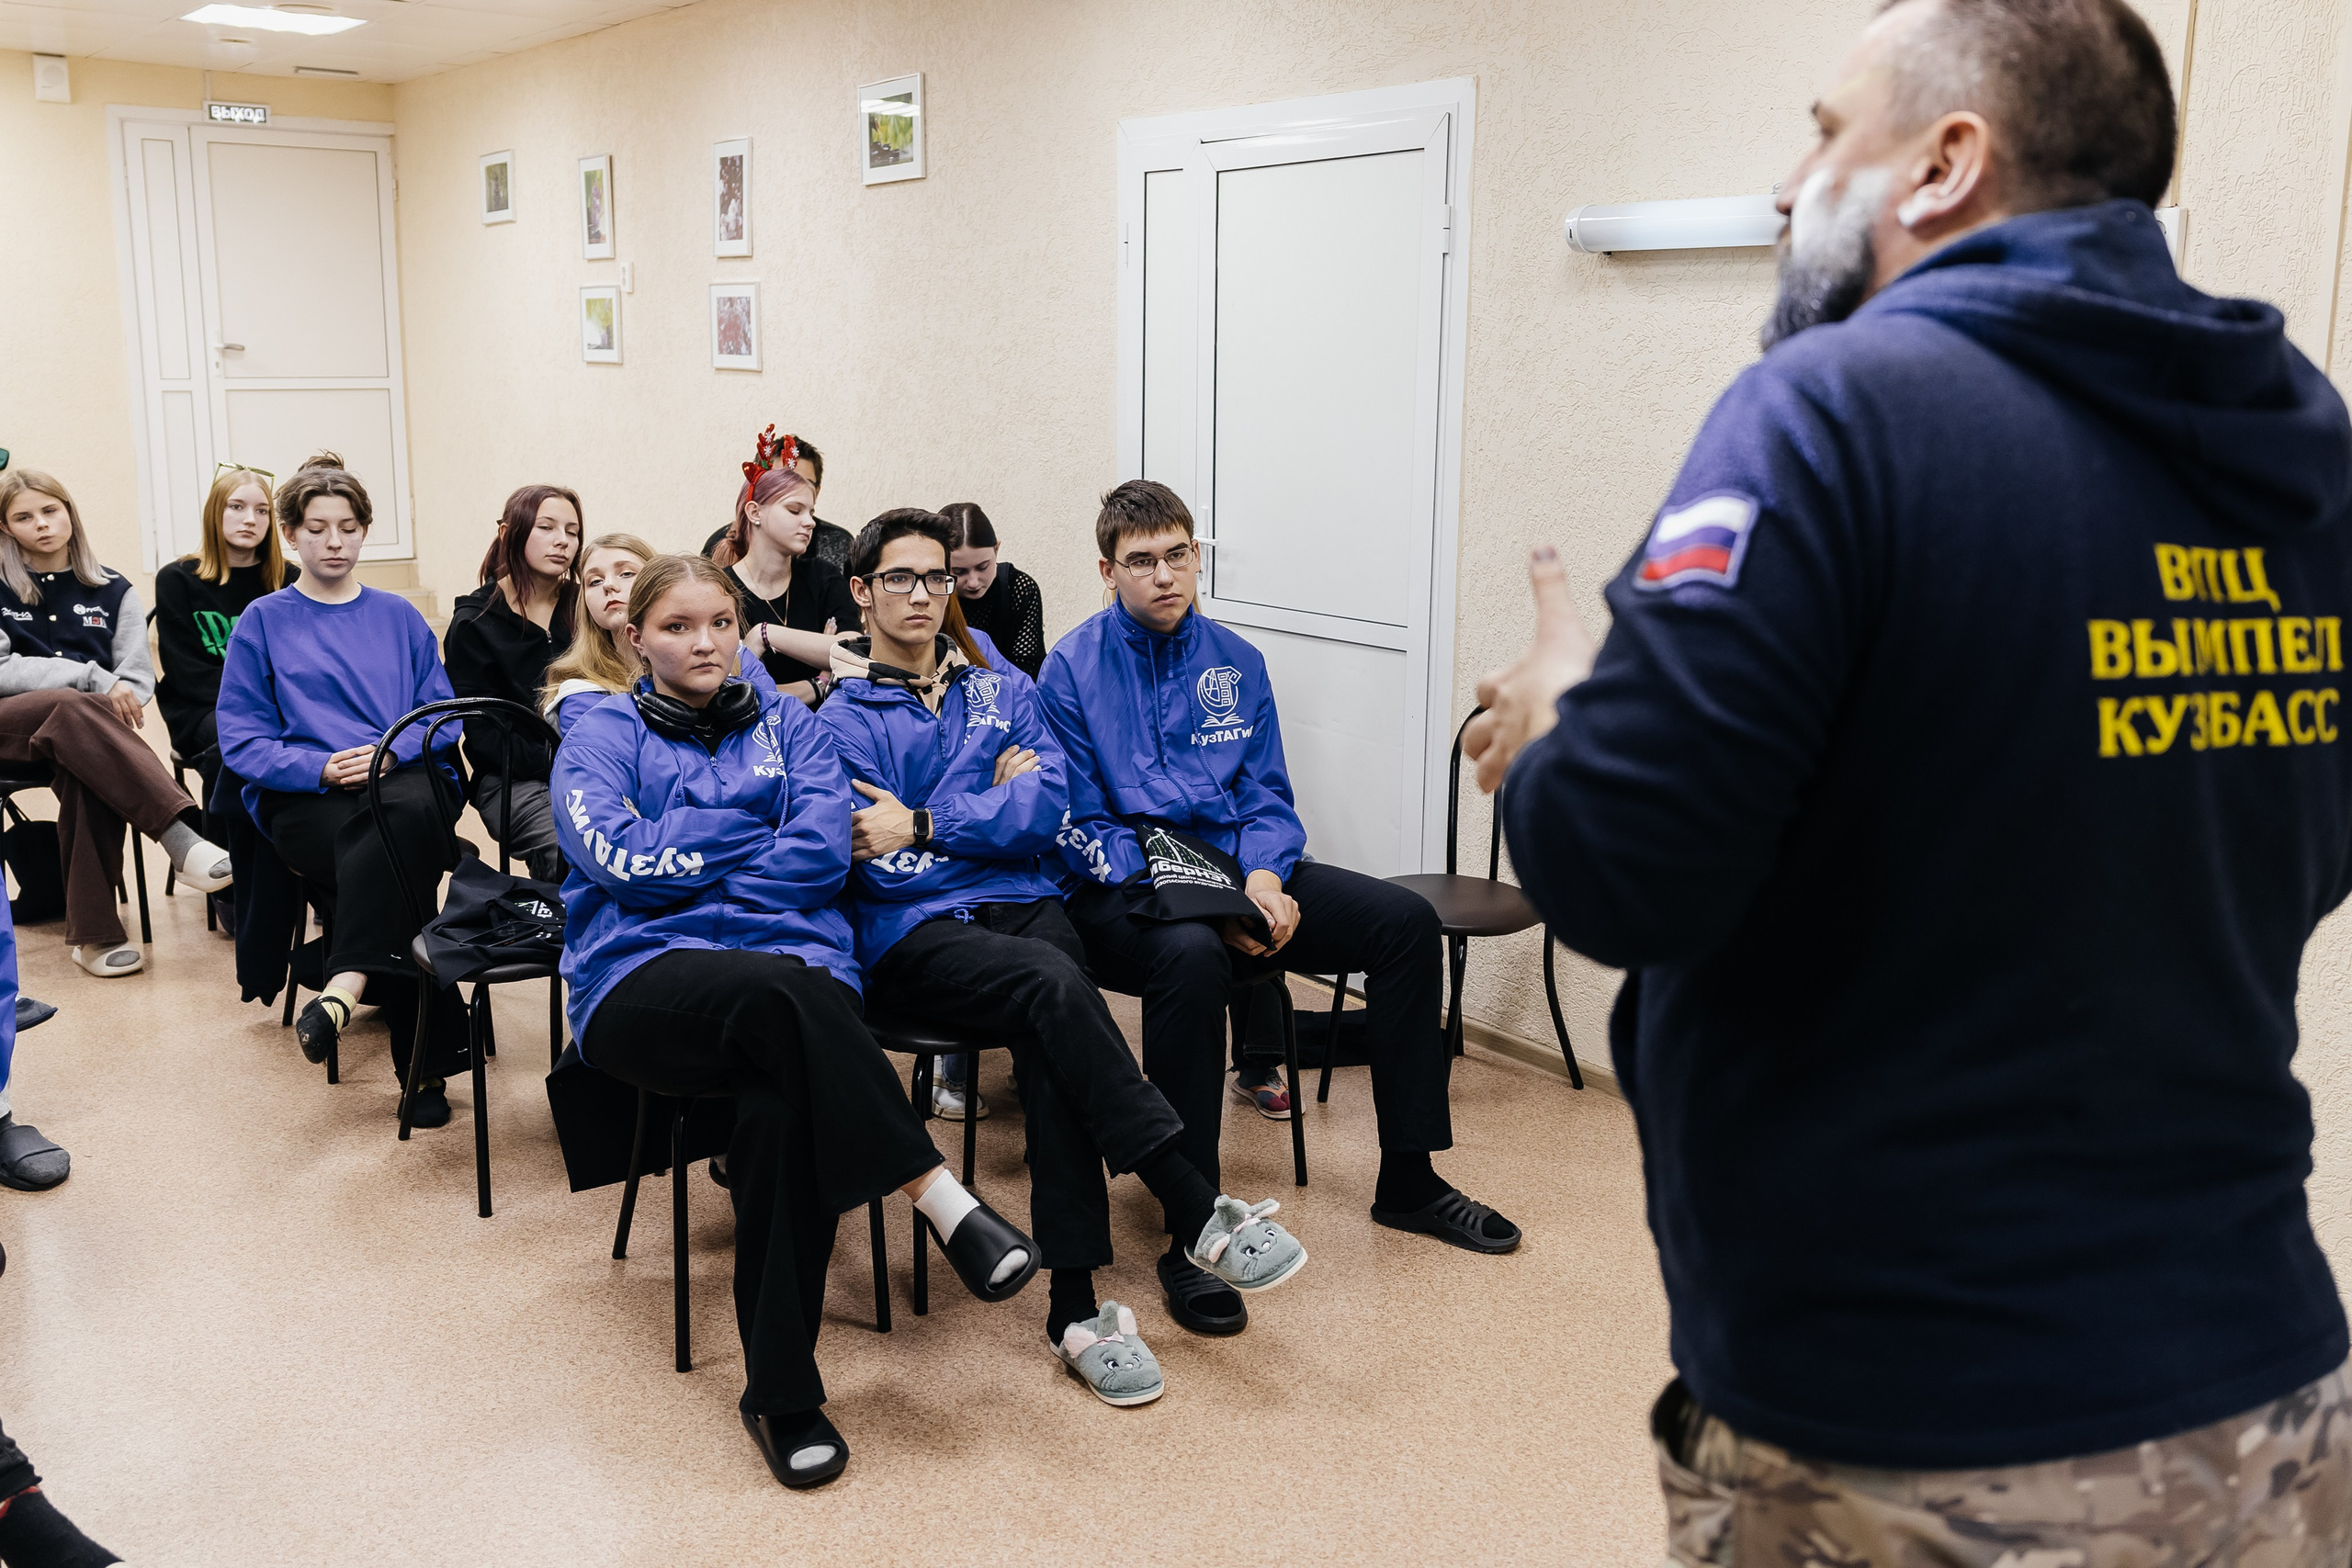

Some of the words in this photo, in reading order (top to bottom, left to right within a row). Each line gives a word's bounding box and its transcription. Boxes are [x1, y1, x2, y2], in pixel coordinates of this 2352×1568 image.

[210, 105, 266, 123] ВЫХОД
[2154, 543, 2282, 613] ВПЦ
[2086, 616, 2345, 679] ВЫМПЕЛ
[2097, 687, 2341, 758] КУЗБАСС
[752, 765, 787, 780] Куз
